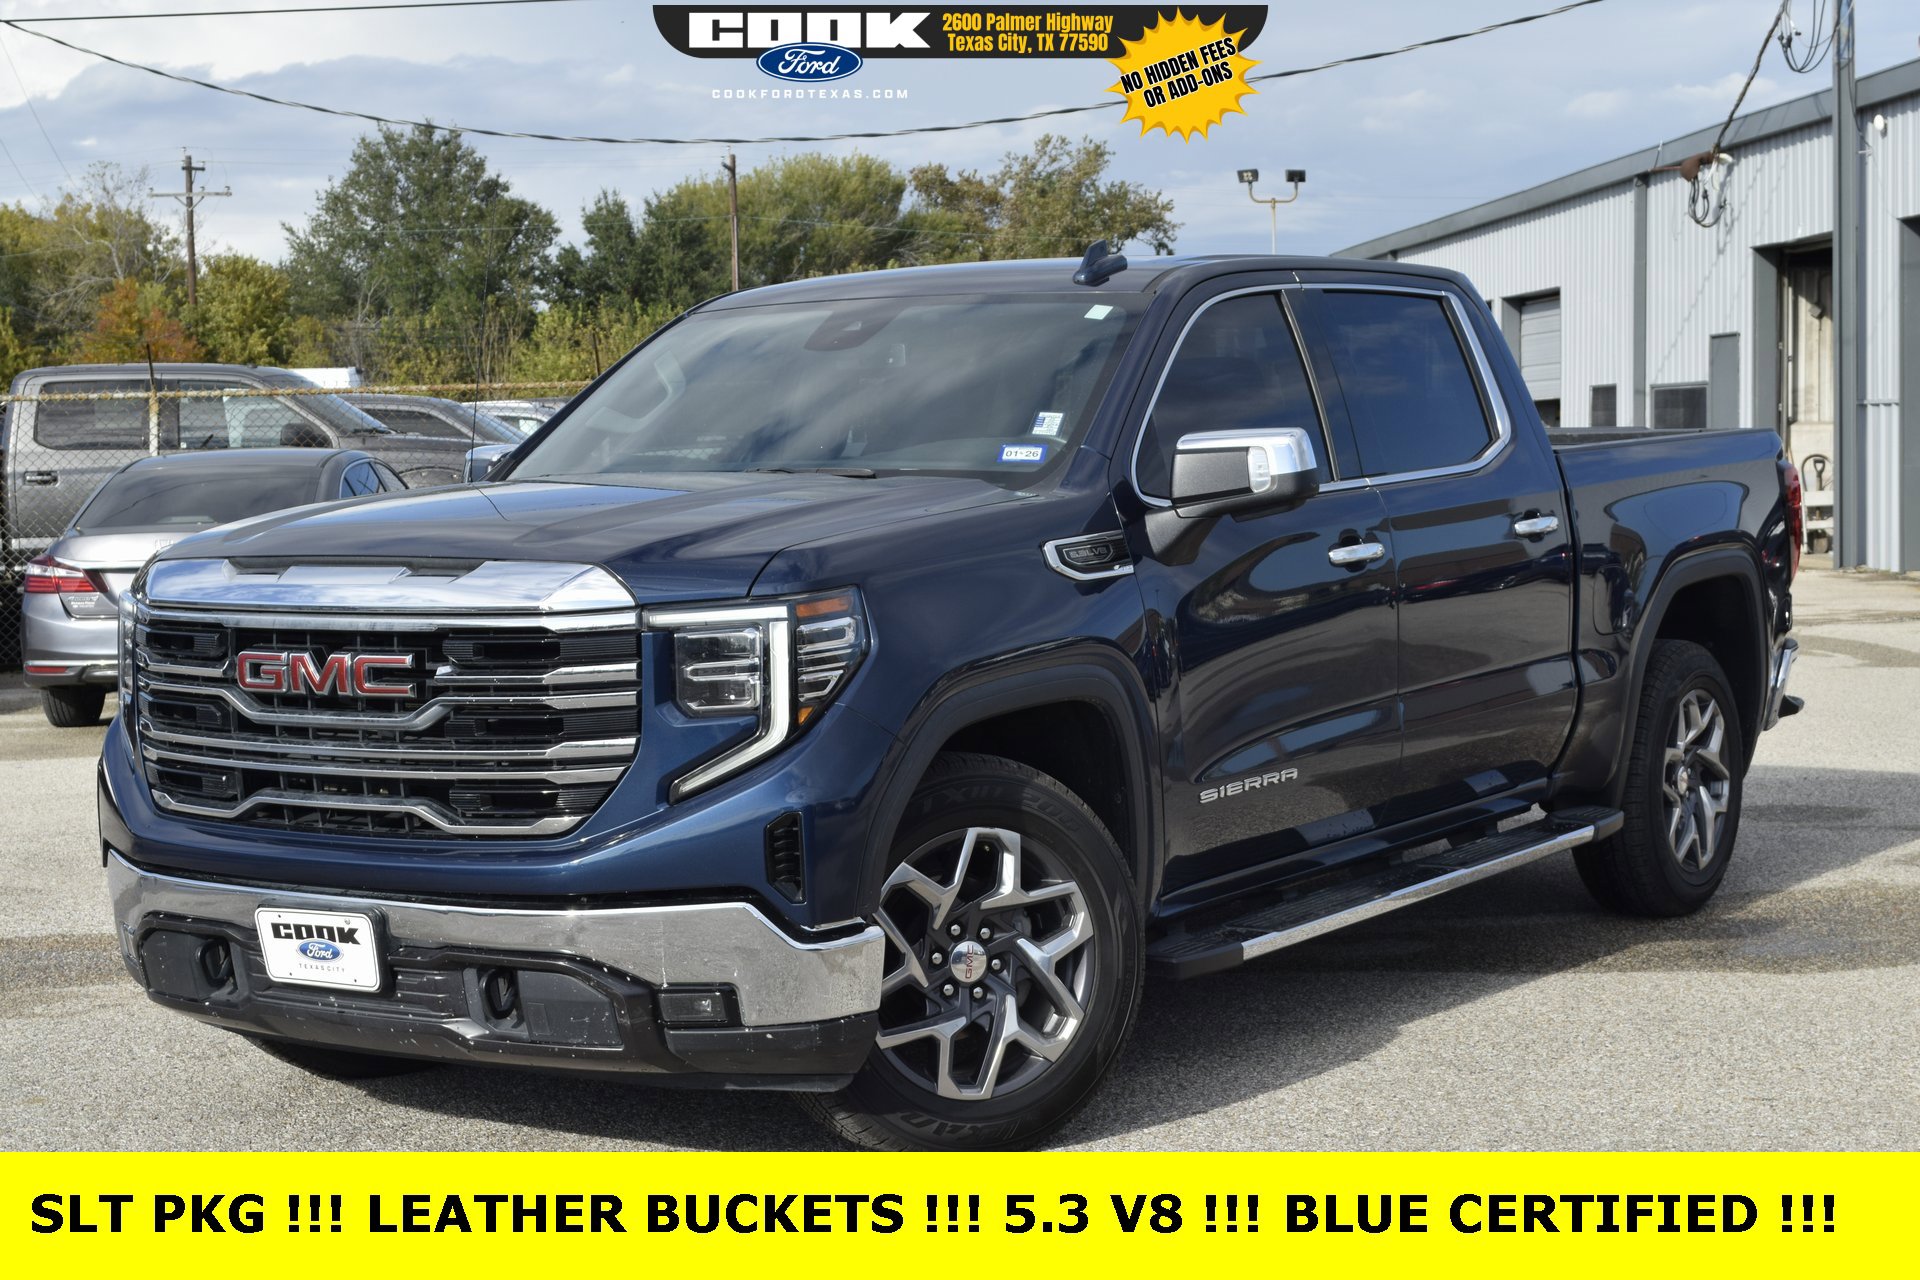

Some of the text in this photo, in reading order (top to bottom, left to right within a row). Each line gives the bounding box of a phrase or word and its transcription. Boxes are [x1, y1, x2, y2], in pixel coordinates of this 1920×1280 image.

[237, 651, 416, 698] GMC
[1199, 767, 1298, 804] SIERRA
[270, 922, 361, 945] COOK
[307, 942, 333, 959] Ford
[965, 944, 974, 979] GMC
[299, 963, 325, 971] TEXAS
